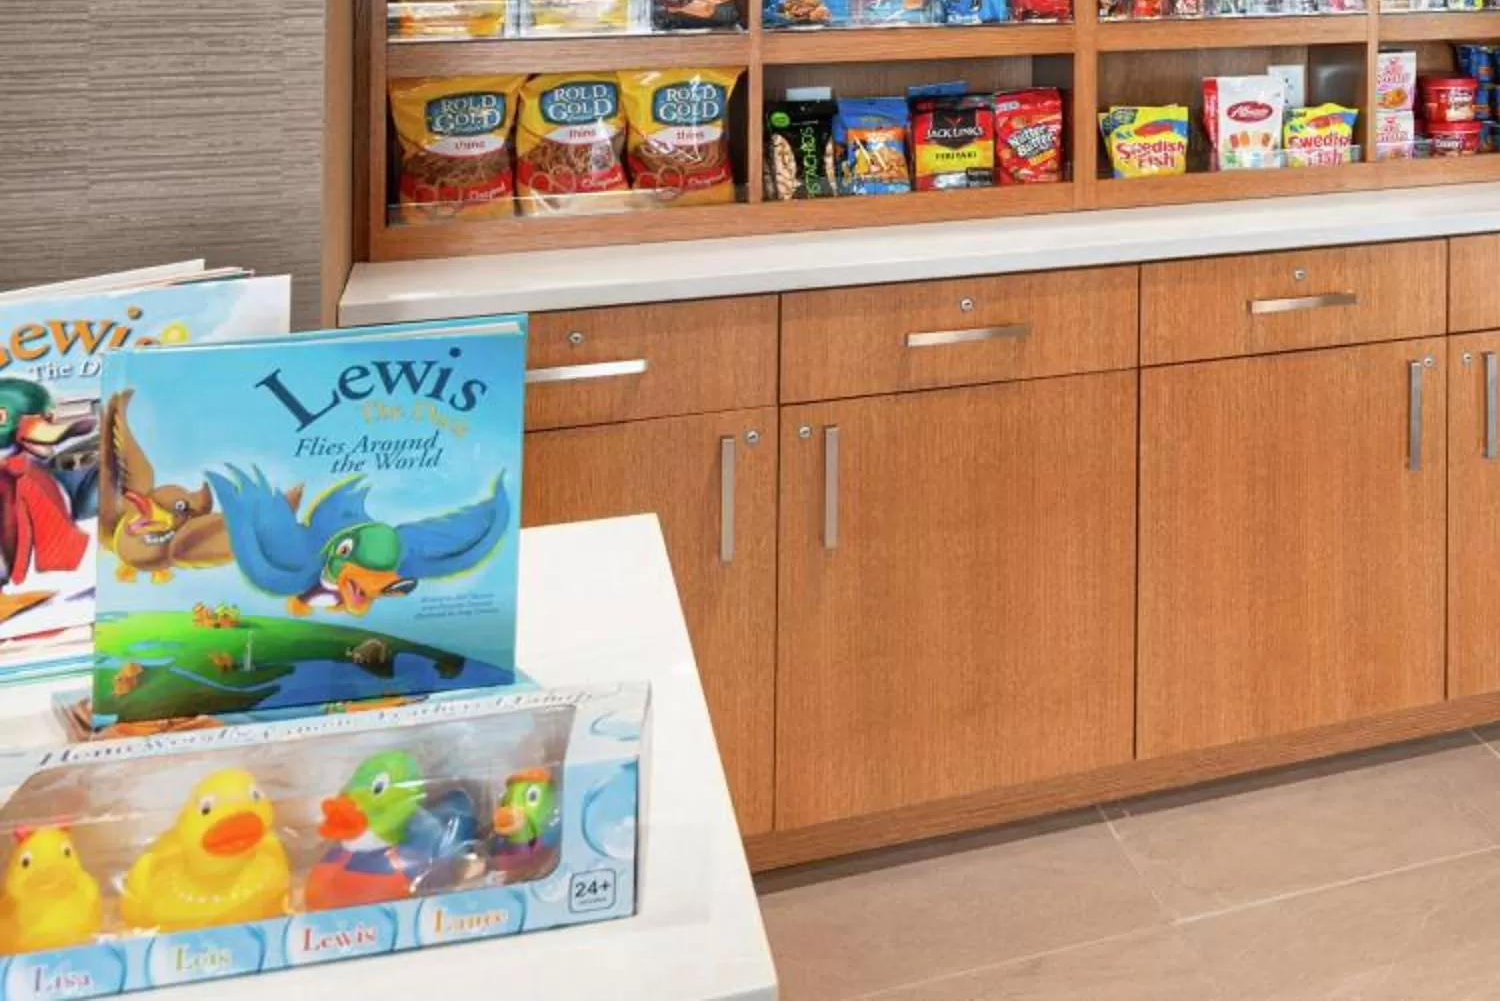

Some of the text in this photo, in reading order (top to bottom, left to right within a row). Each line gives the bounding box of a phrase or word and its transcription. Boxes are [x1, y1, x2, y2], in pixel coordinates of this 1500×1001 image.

[440, 94, 498, 114] ROLD
[552, 84, 608, 102] ROLD
[666, 84, 718, 102] ROLD
[435, 109, 501, 132] GOLD
[547, 100, 613, 121] GOLD
[659, 100, 720, 121] GOLD
[254, 347, 488, 433] Lewis
[293, 429, 439, 458] Flies Around
[330, 448, 443, 474] the World
[574, 880, 611, 898] 24+
[303, 923, 376, 952] Lewis
[35, 966, 90, 993] Lisa
